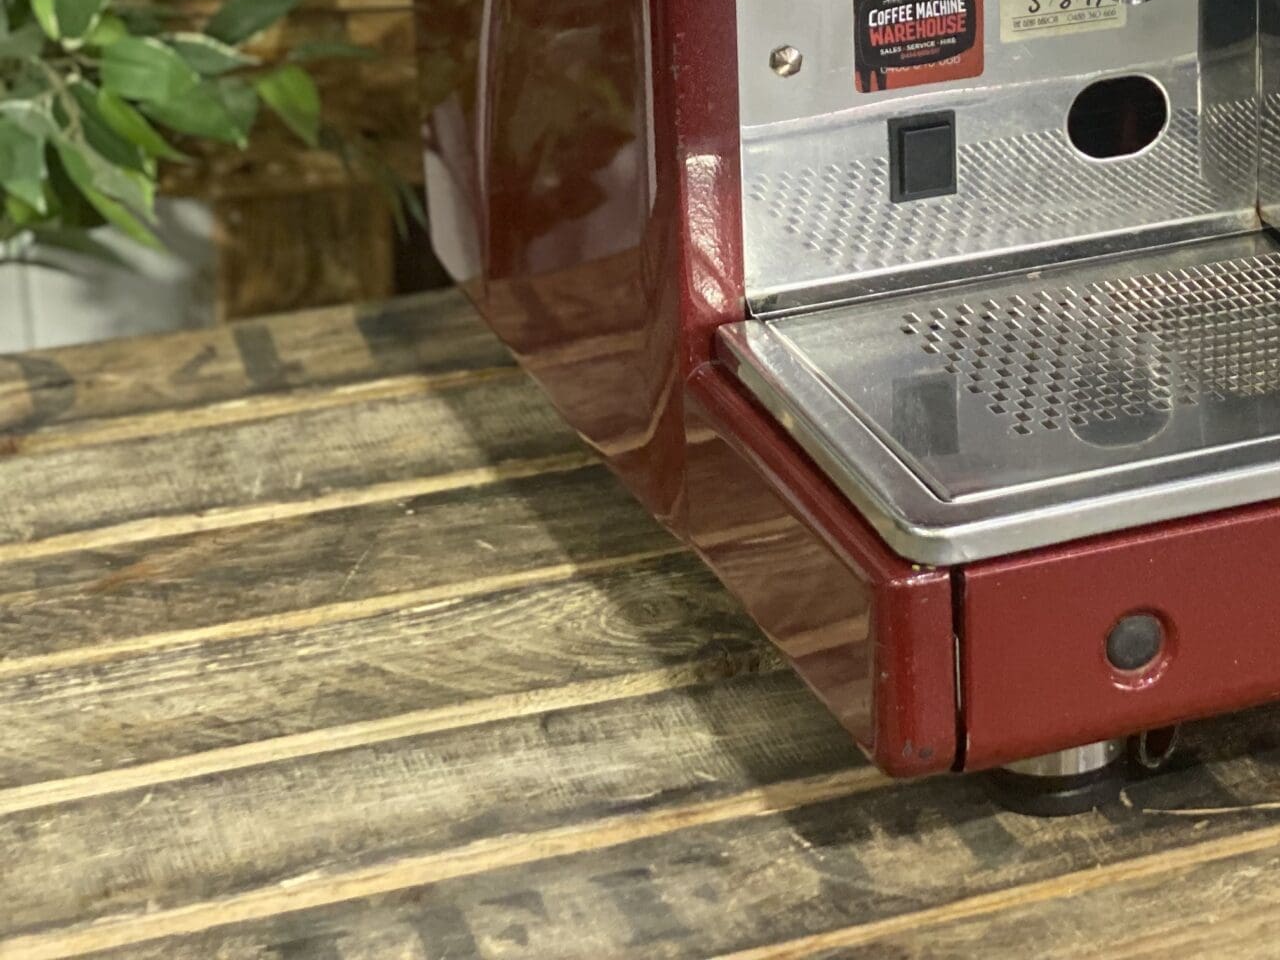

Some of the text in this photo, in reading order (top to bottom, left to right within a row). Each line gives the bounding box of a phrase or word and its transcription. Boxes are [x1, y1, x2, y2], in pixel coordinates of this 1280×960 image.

[868, 3, 913, 27] COFFEE
[869, 13, 967, 47] WAREHOUSE
[880, 45, 902, 56] SALES
[906, 40, 936, 51] SERVICE
[940, 36, 957, 46] HIRE
